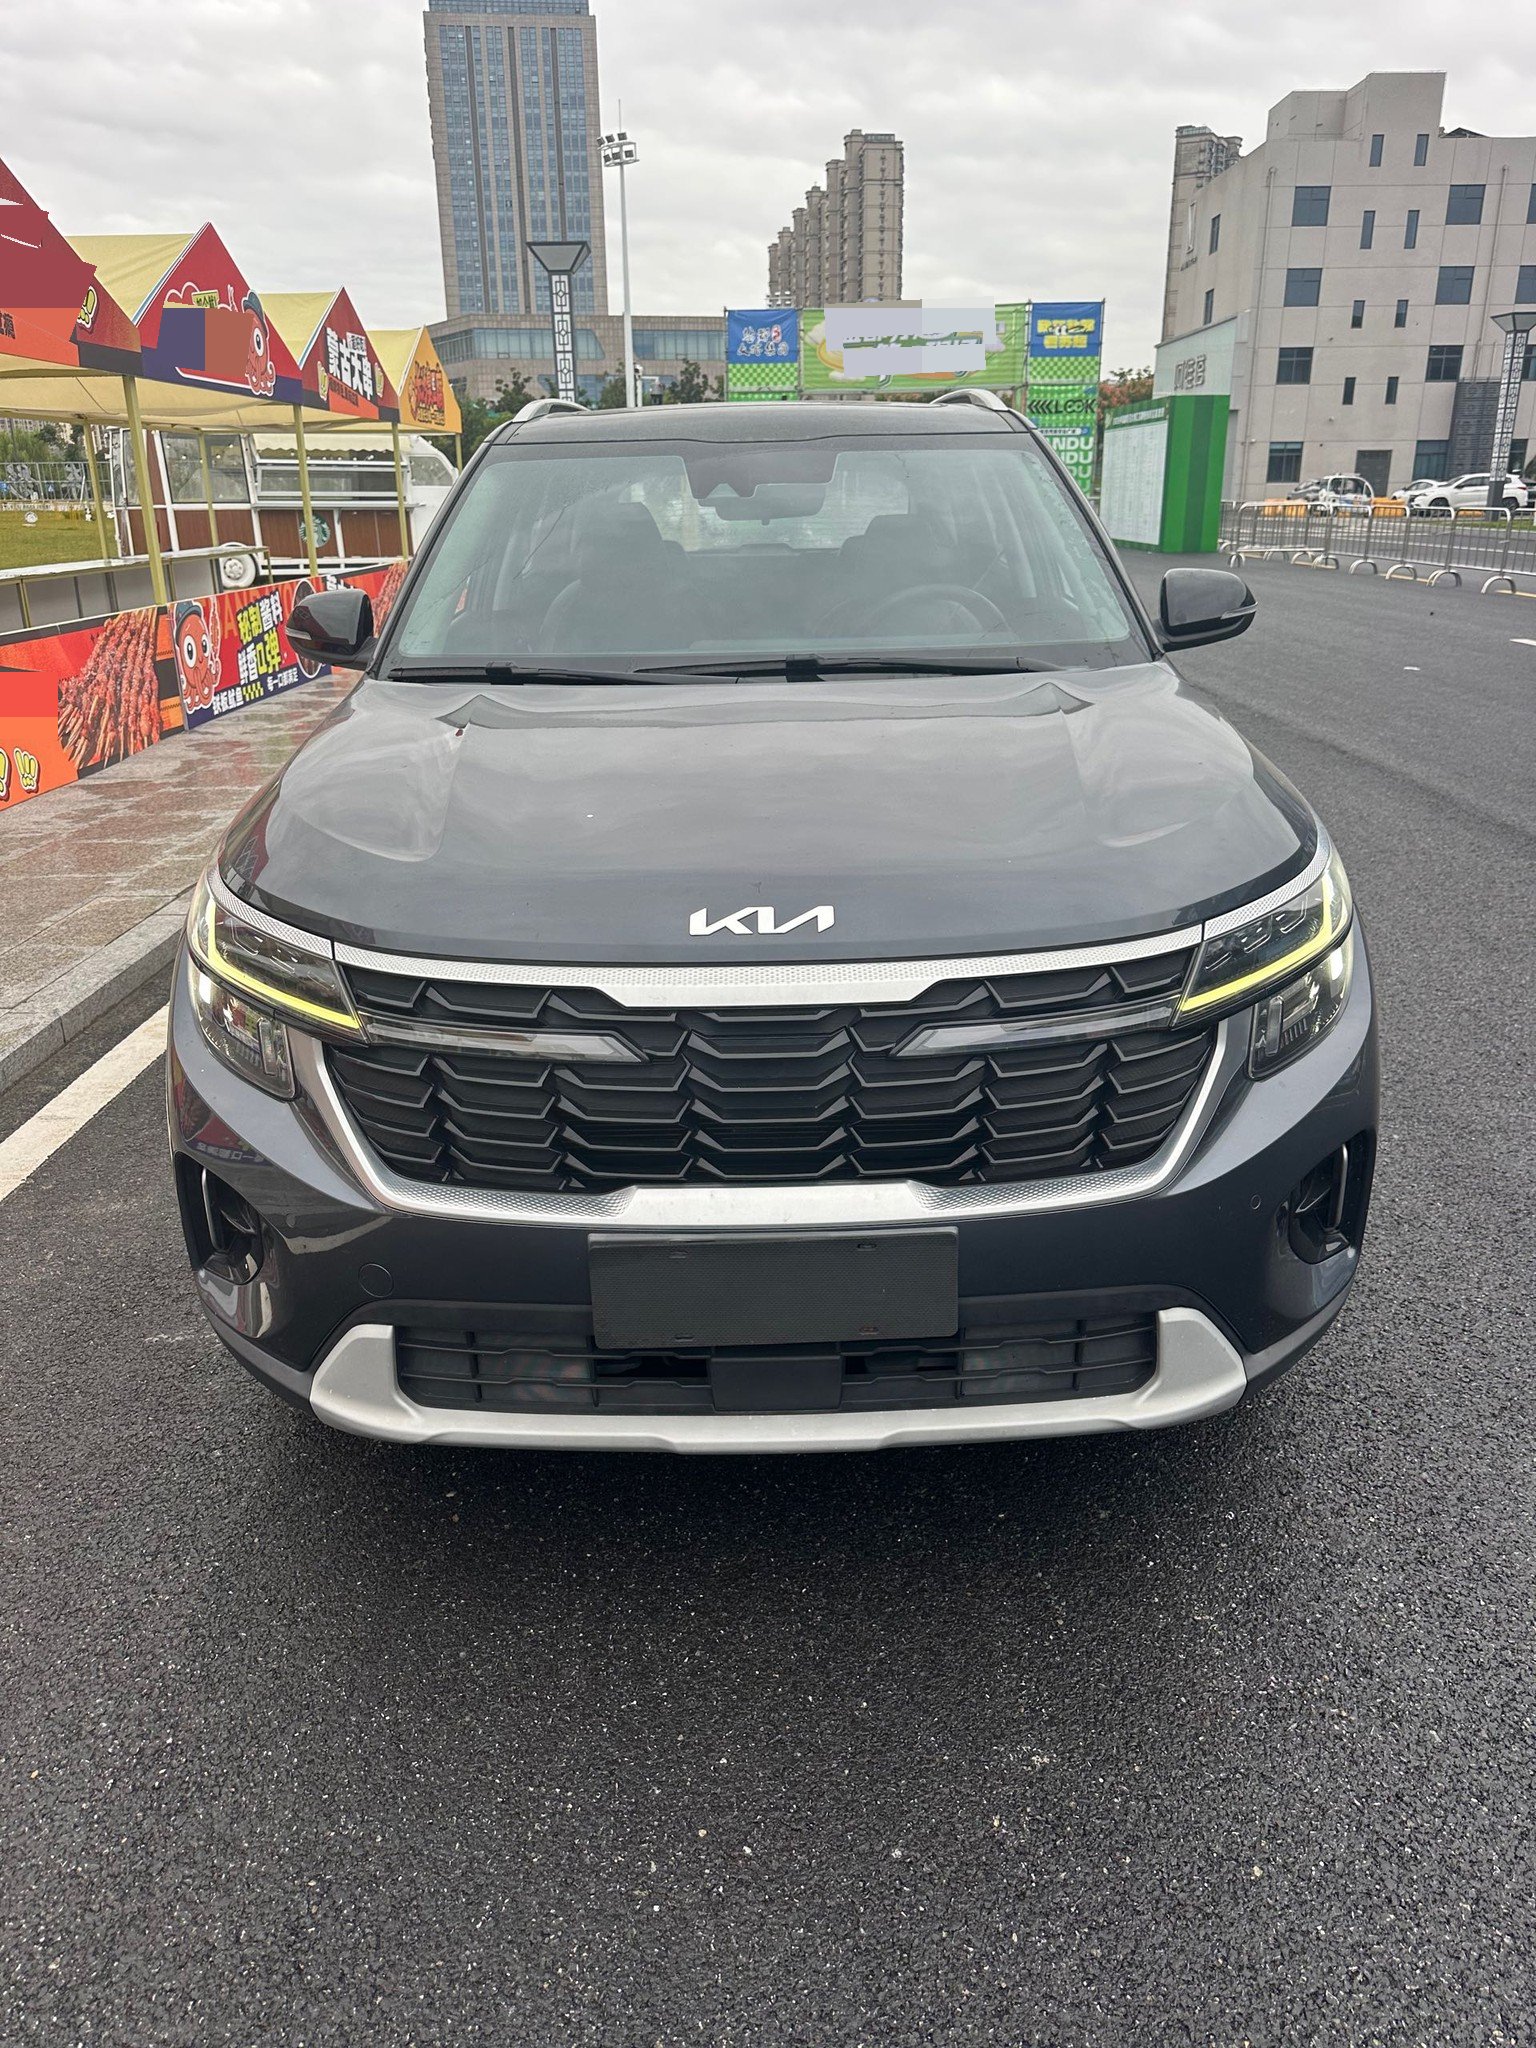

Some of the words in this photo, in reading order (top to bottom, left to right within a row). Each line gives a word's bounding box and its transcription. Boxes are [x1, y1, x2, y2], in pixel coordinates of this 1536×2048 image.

[325, 327, 374, 401] 蒙古大串
[1054, 398, 1097, 414] LOOK
[1047, 436, 1095, 451] NDU
[236, 590, 284, 645] 秘制酱料
[237, 626, 283, 686] 鲜香Q弹
[212, 686, 244, 716] 铁板鱿鱼
[689, 905, 835, 936] KIA
